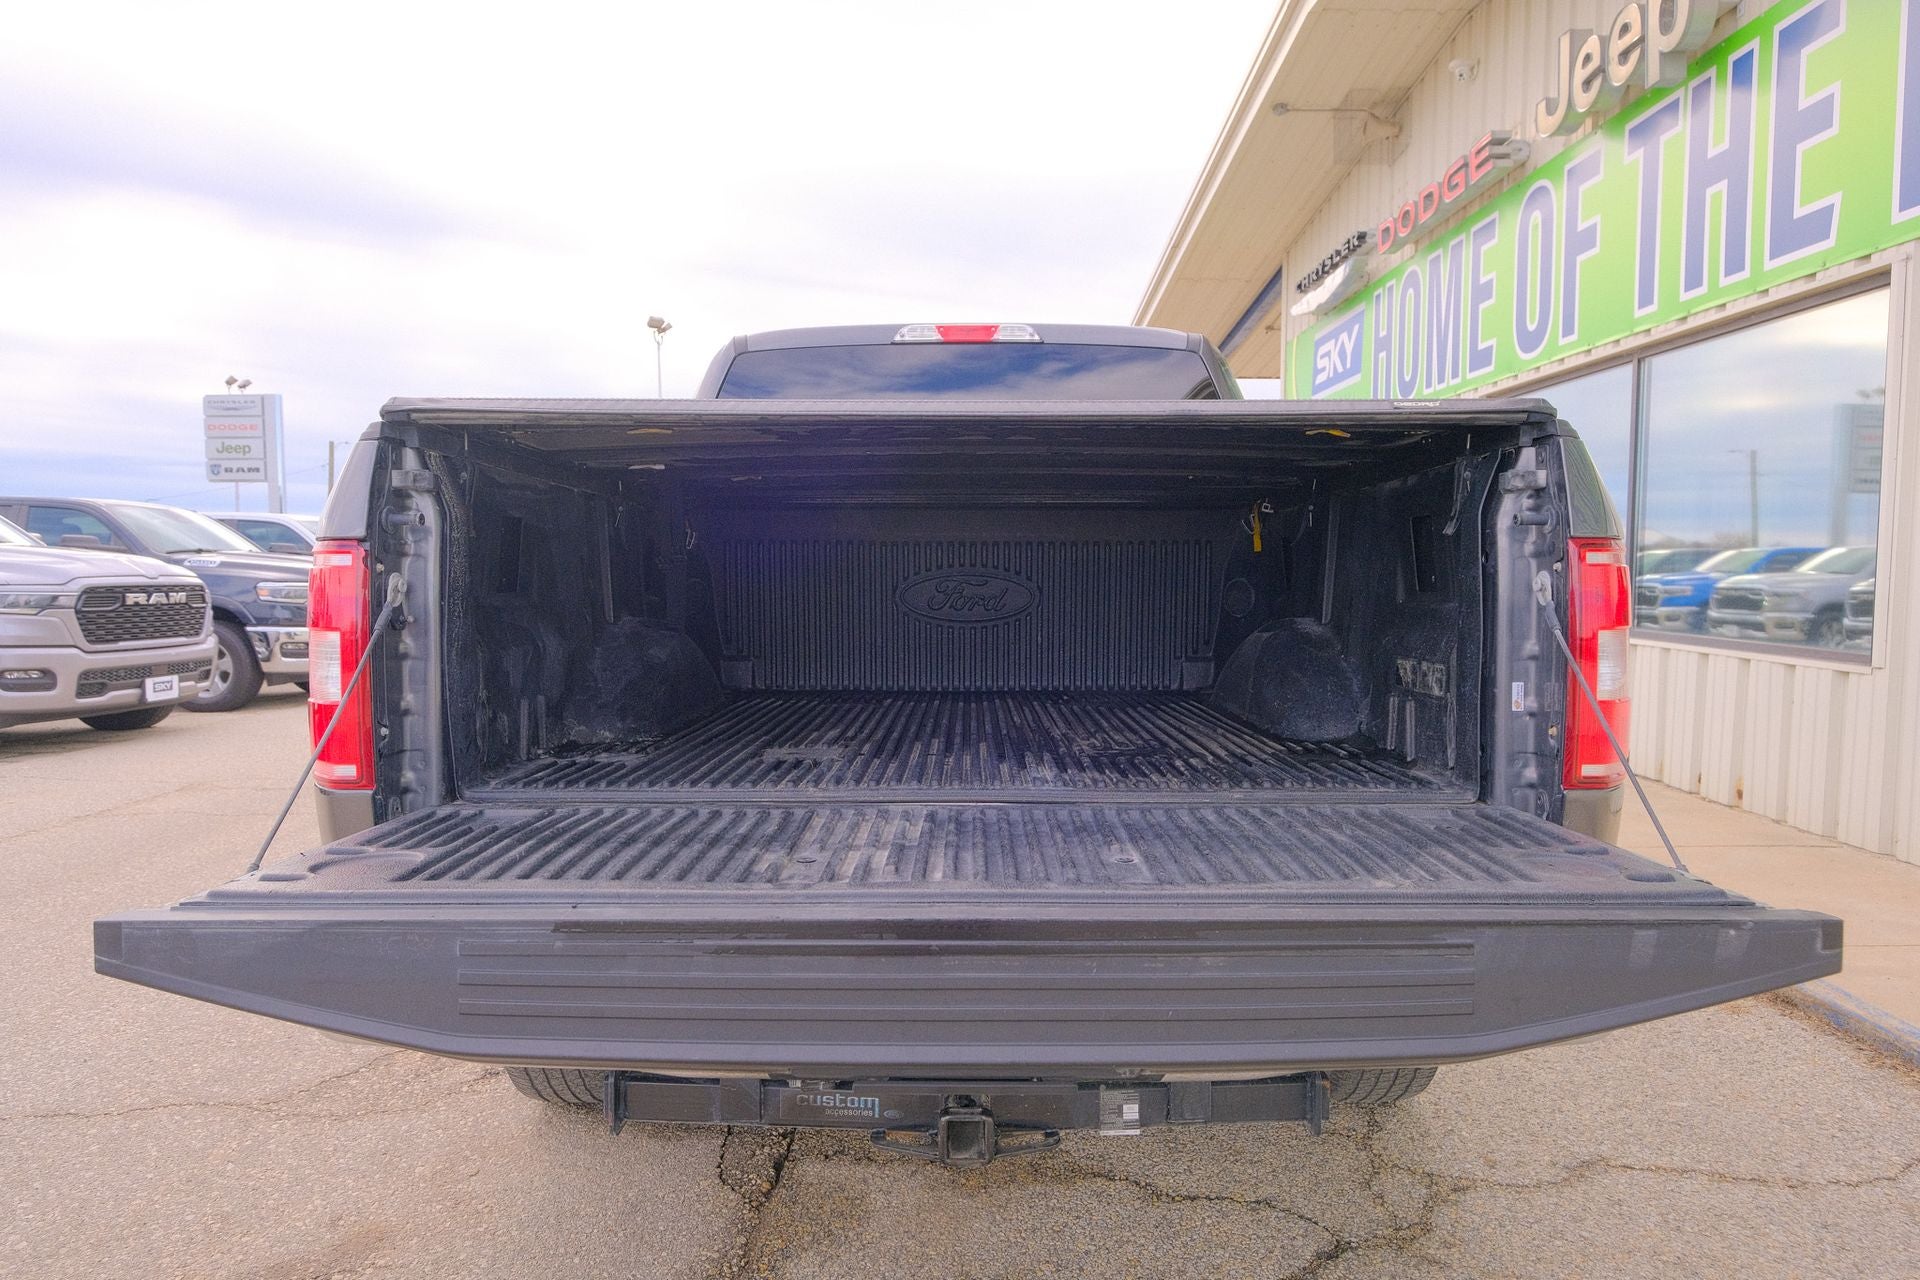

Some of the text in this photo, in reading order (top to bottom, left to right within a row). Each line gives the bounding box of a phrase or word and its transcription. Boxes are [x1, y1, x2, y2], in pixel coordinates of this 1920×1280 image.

[1536, 0, 1690, 138] Jeep
[1372, 211, 1498, 400] HOME
[1514, 142, 1605, 360] OF
[1624, 0, 1848, 319] THE
[1376, 131, 1494, 255] DODGE
[1296, 230, 1367, 293] CHRYSLER
[1315, 323, 1360, 385] SKY
[216, 441, 252, 456] Jeep
[124, 592, 187, 605] RAM
[928, 579, 1009, 611] Ford
[154, 682, 172, 690] SKY
[796, 1094, 880, 1118] custom
[825, 1108, 873, 1117] accessories
